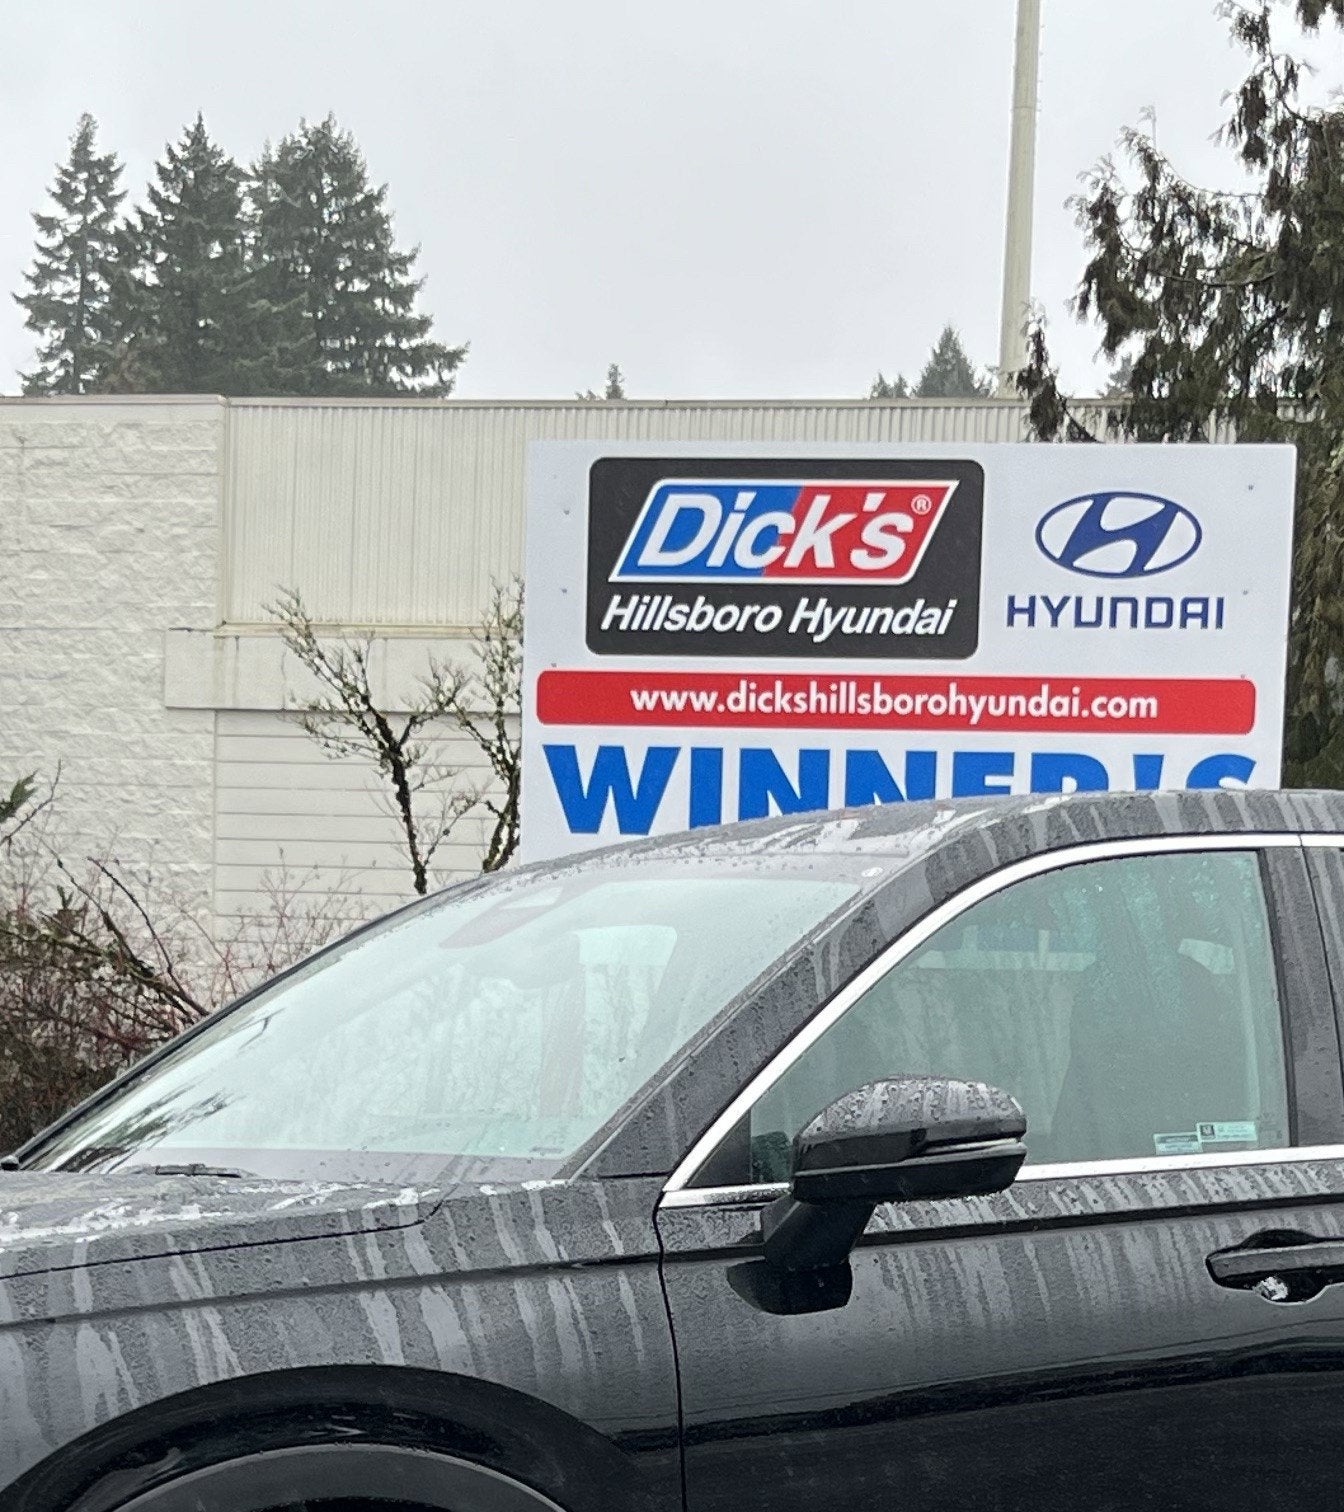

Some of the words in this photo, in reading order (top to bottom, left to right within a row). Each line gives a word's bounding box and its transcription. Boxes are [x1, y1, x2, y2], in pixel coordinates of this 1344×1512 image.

[636, 491, 915, 570] Dick's
[600, 594, 783, 634] Hillsboro
[787, 598, 958, 643] Hyundai
[1006, 595, 1225, 630] HYUNDAI
[630, 681, 1158, 726] www.dickshillsborohyundai.com
